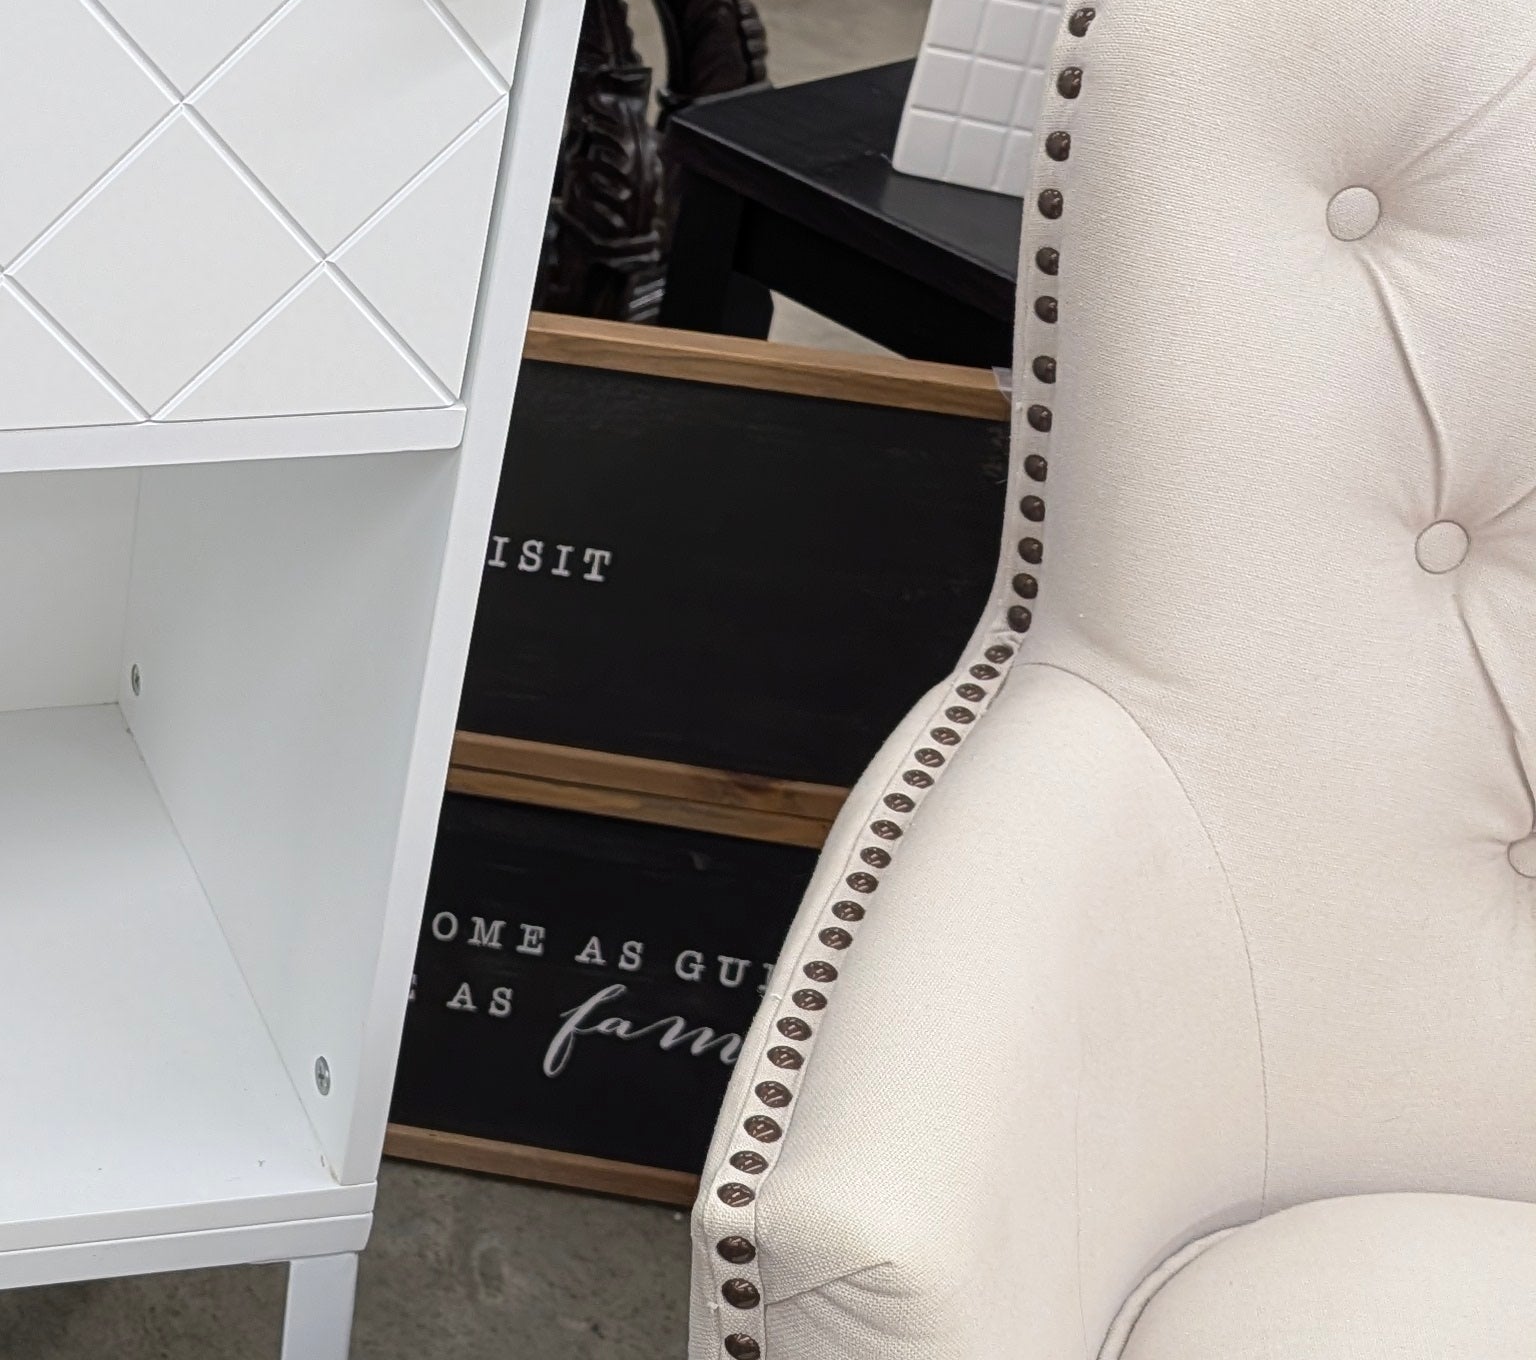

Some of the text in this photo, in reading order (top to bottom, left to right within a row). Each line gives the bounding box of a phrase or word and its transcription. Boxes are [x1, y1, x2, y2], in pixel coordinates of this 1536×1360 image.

[488, 535, 613, 582] ISIT
[432, 911, 546, 956] OME
[575, 936, 645, 971] AS
[446, 982, 514, 1018] AS
[543, 983, 741, 1079] fam
